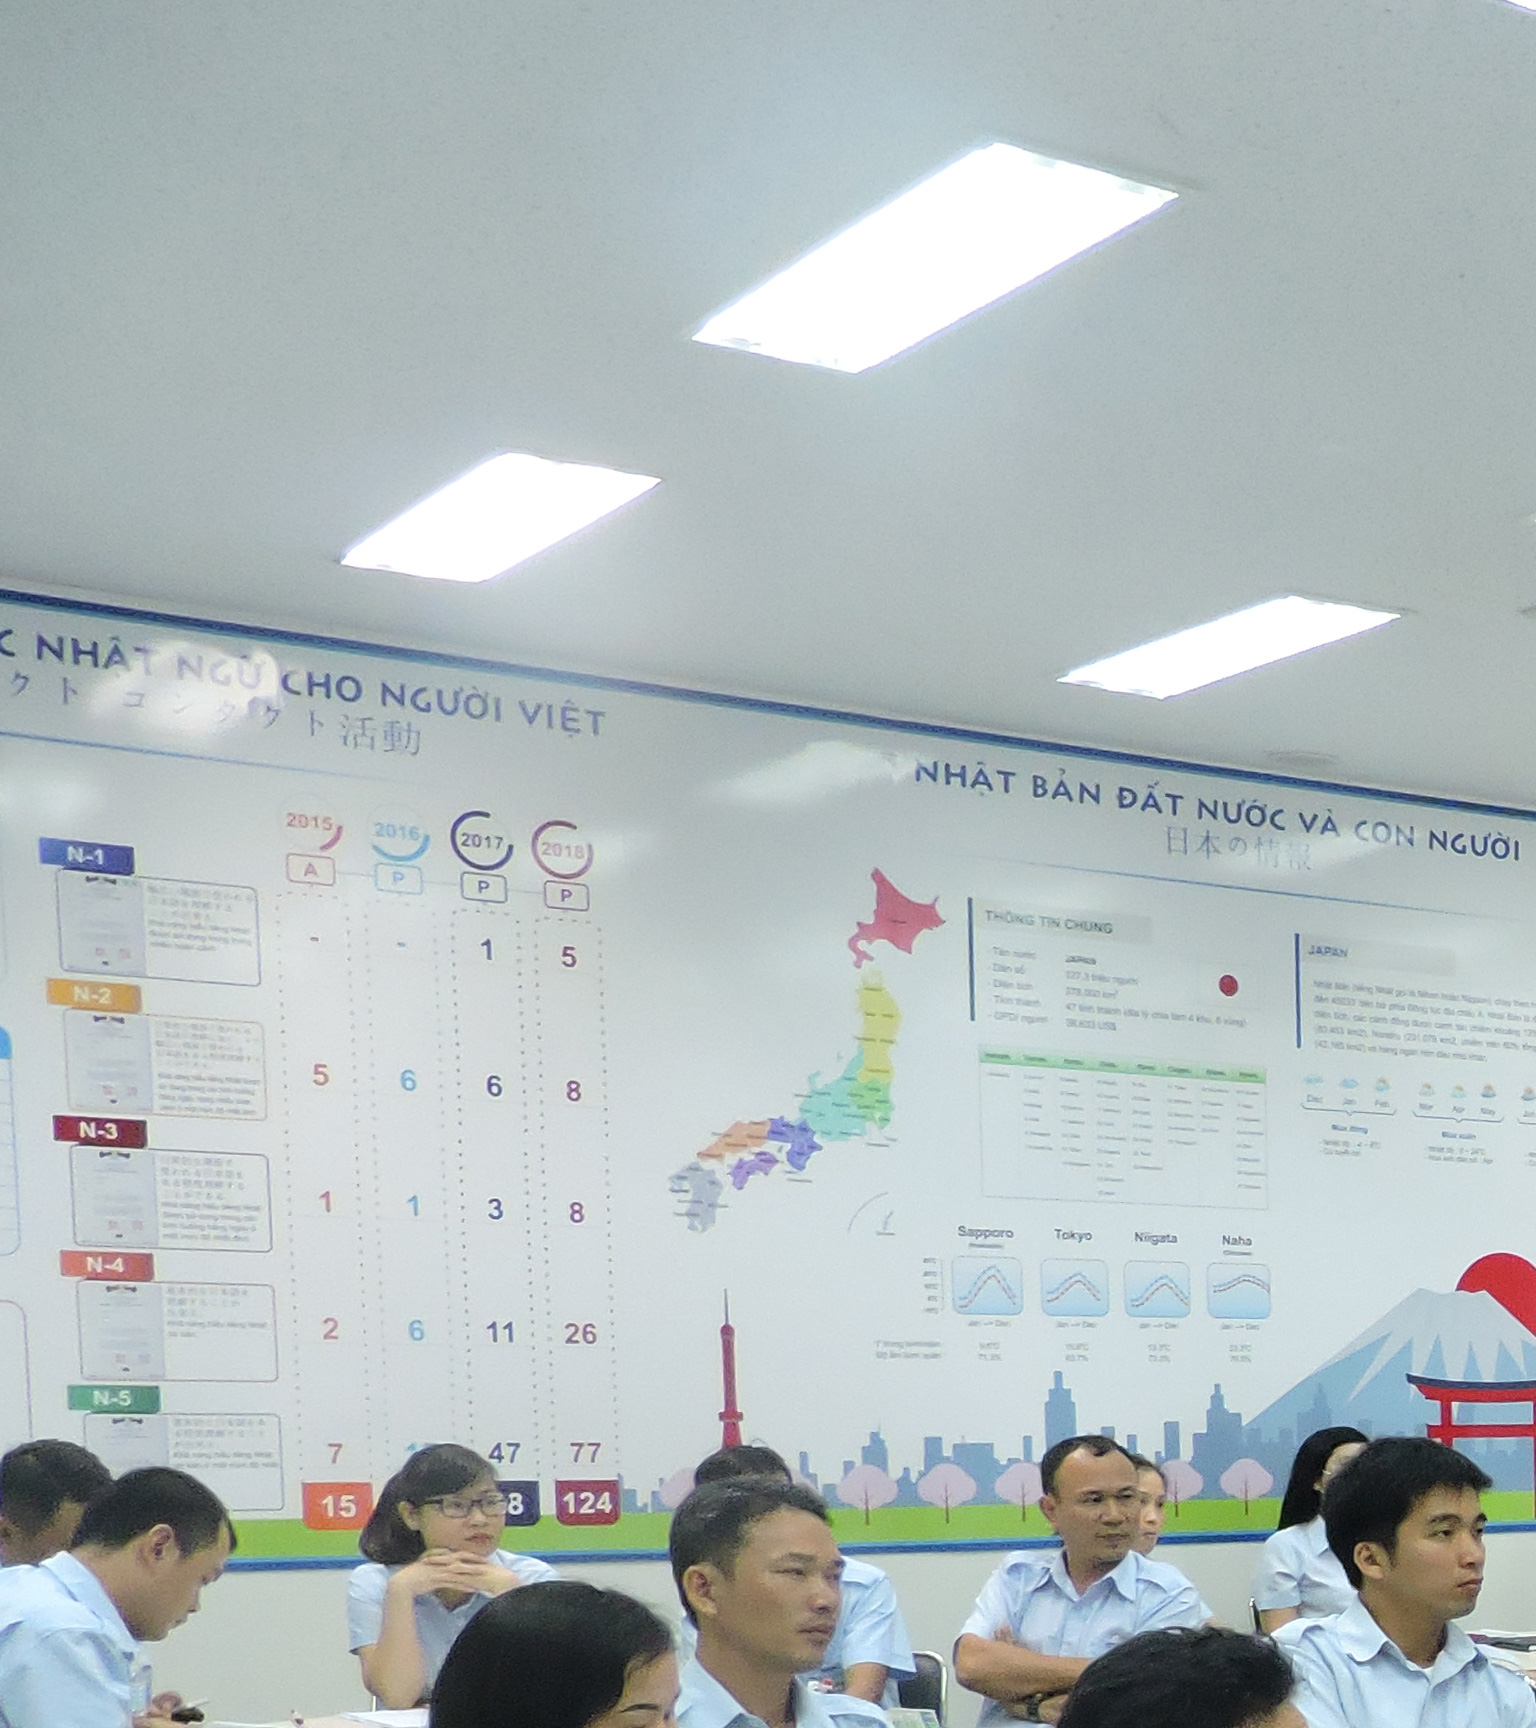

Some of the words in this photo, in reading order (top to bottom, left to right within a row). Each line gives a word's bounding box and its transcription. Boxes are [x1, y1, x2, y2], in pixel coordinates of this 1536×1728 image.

[281, 671, 363, 703] CHO
[380, 682, 502, 722] NGƯỜI
[518, 699, 606, 738] VIỆT
[914, 761, 1017, 796] NHẬT
[1032, 768, 1101, 805] BẢN
[1116, 780, 1184, 817] ĐẤT
[1198, 798, 1286, 831] NƯỚC
[1298, 808, 1340, 837] VÀ
[1355, 819, 1415, 847] CON
[1428, 830, 1520, 861] NGƯỜI
[287, 812, 333, 831] 2015
[374, 821, 420, 841] 2016
[460, 832, 504, 850] 2017
[67, 846, 105, 865] N-1
[541, 842, 586, 860] 2018
[304, 863, 317, 877] A
[477, 880, 490, 894] P
[561, 889, 573, 902] P
[1064, 918, 1114, 935] CHUNG
[480, 938, 493, 961] 1
[561, 946, 577, 967] 5
[73, 985, 112, 1004] N-2
[312, 1063, 329, 1086] 5
[400, 1069, 417, 1091] 6
[486, 1074, 503, 1097] 6
[565, 1080, 582, 1102] 8
[79, 1121, 118, 1139] N-3
[319, 1190, 332, 1213] 1
[407, 1195, 419, 1217] 1
[487, 1198, 504, 1220] 3
[569, 1202, 585, 1223] 8
[957, 1225, 1014, 1241] Sapporo
[1054, 1228, 1093, 1243] Tokyo
[1222, 1235, 1253, 1247] Naha
[86, 1257, 124, 1274] N-4
[322, 1317, 339, 1340] 2
[408, 1319, 425, 1341] 6
[486, 1321, 515, 1343] 11
[564, 1322, 597, 1345] 26
[92, 1390, 131, 1407] N-5
[327, 1442, 343, 1464] 7
[488, 1442, 521, 1464] 47
[569, 1442, 603, 1464] 77
[322, 1495, 356, 1518] 15
[563, 1492, 613, 1514] 124
